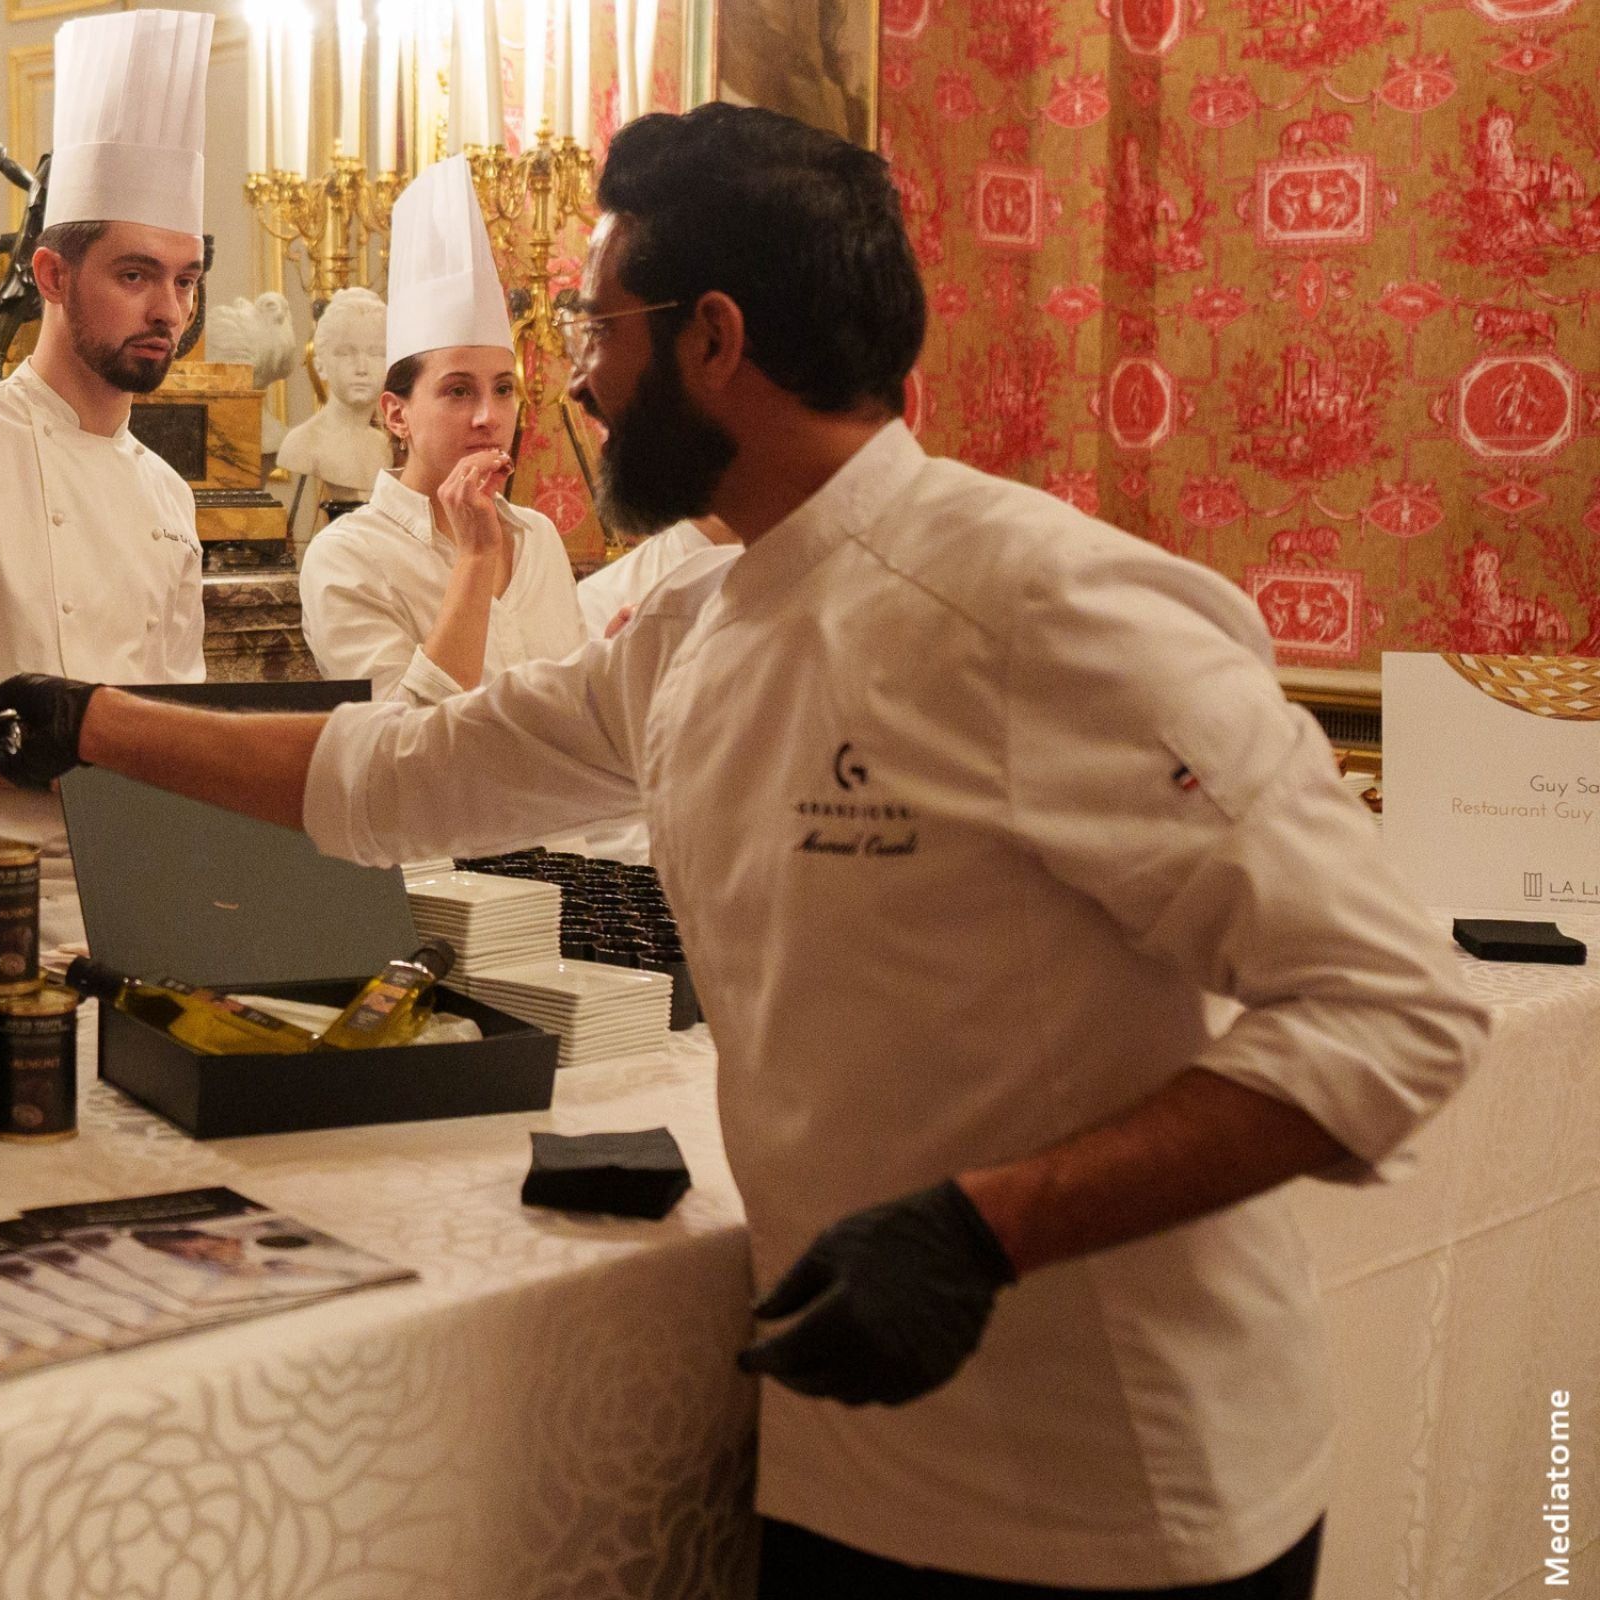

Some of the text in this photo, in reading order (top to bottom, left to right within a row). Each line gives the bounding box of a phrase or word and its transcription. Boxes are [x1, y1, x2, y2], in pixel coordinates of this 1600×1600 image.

[1529, 774, 1600, 797] Guy Sa
[1452, 797, 1593, 823] Restaurant Guy
[1549, 881, 1574, 894] LA
